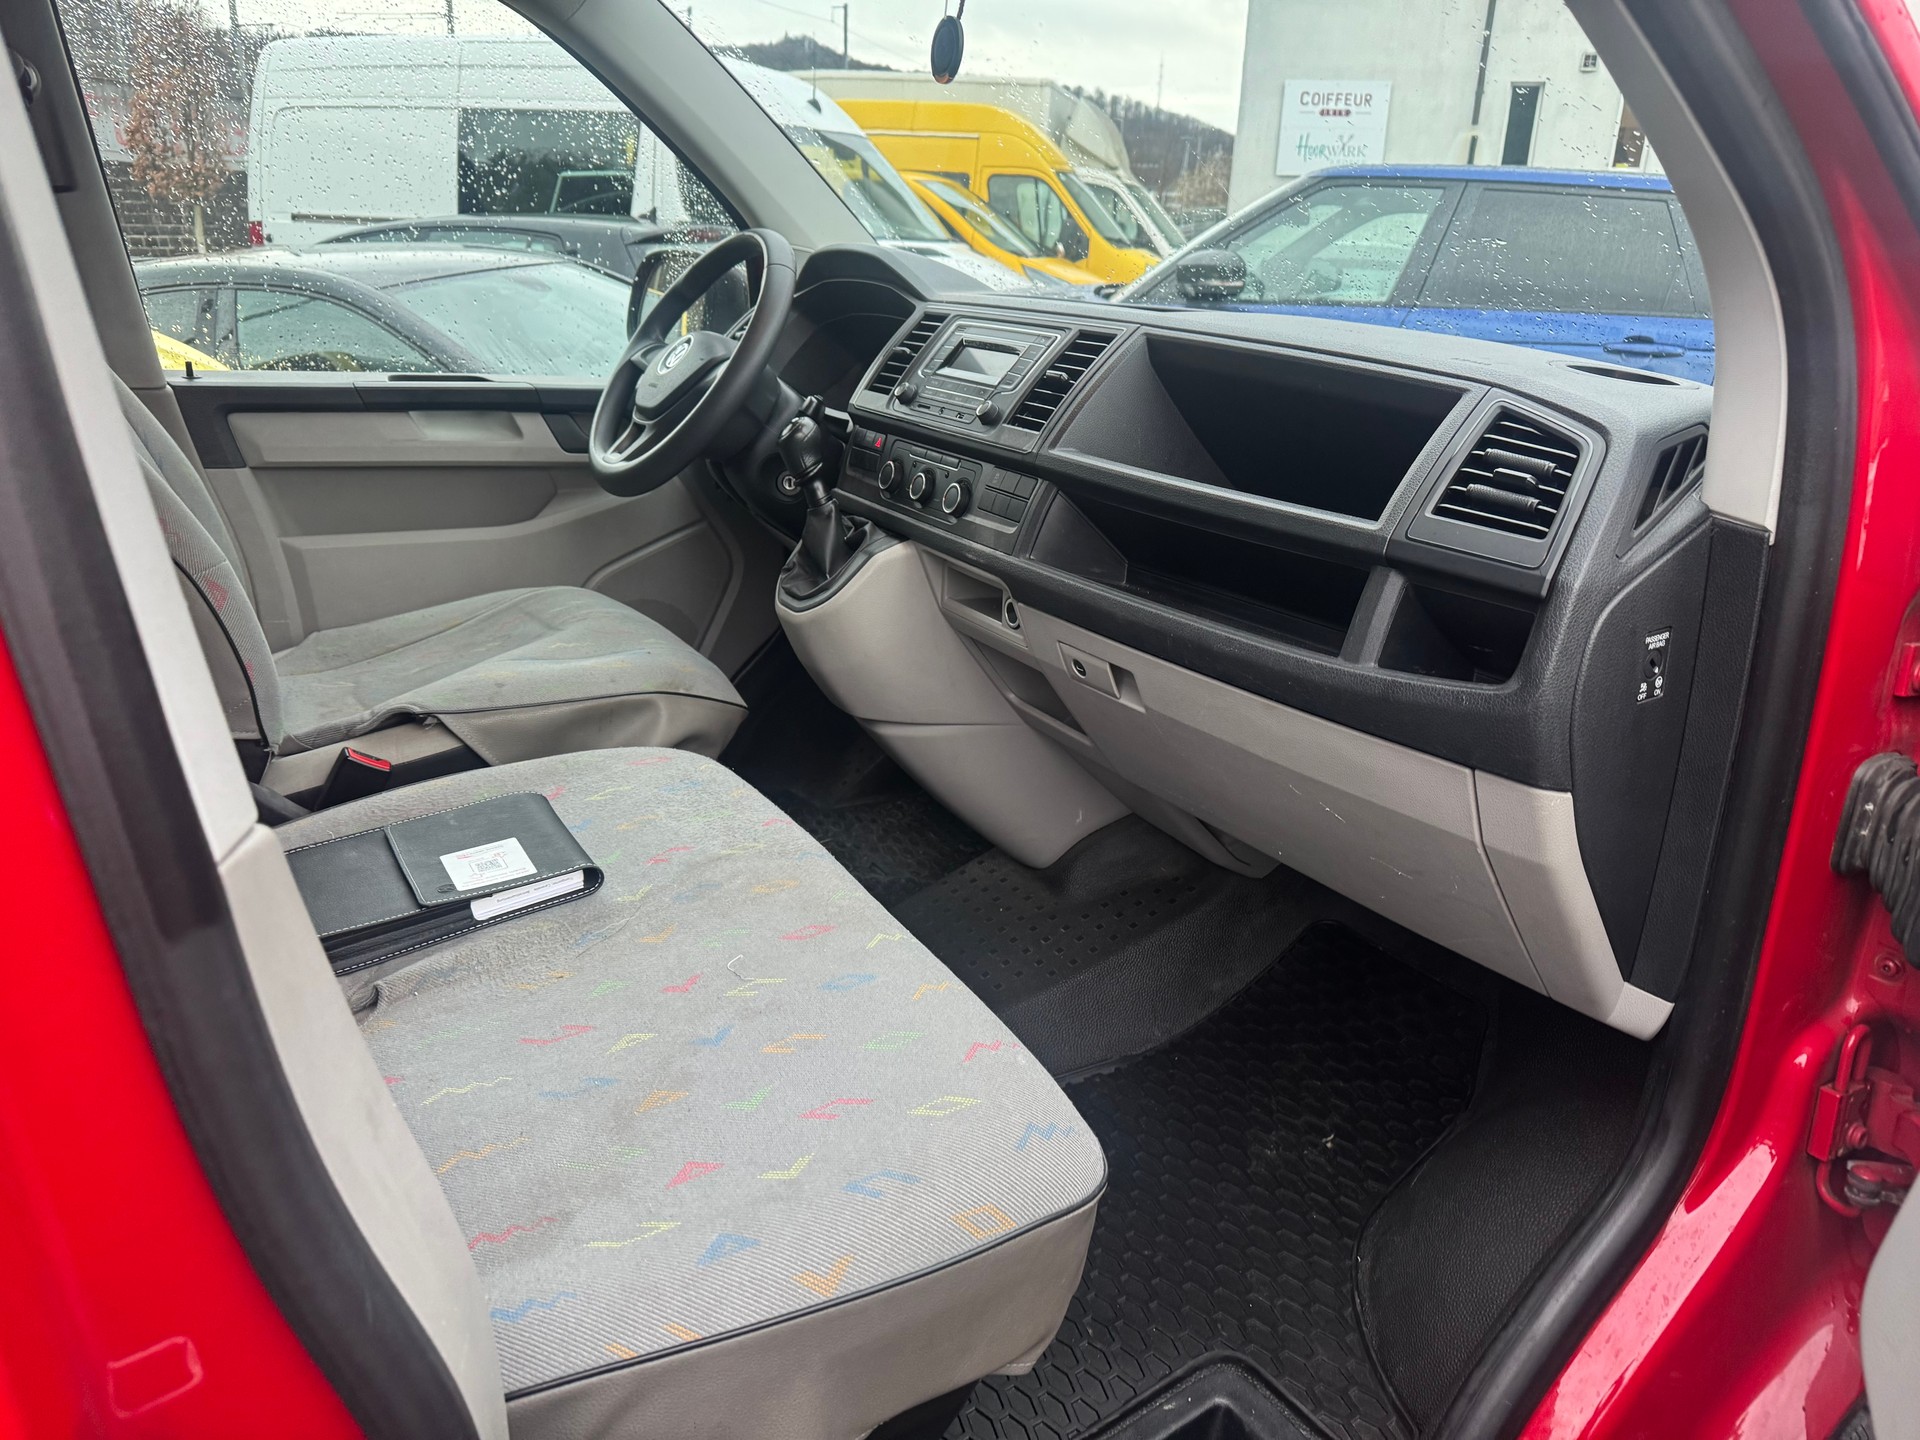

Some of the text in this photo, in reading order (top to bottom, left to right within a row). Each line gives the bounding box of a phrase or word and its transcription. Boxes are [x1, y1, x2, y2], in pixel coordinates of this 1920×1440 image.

[1299, 90, 1373, 107] COIFFEUR
[1645, 631, 1670, 645] PASSENGER
[1637, 692, 1647, 701] OFF
[1653, 688, 1662, 696] ON
